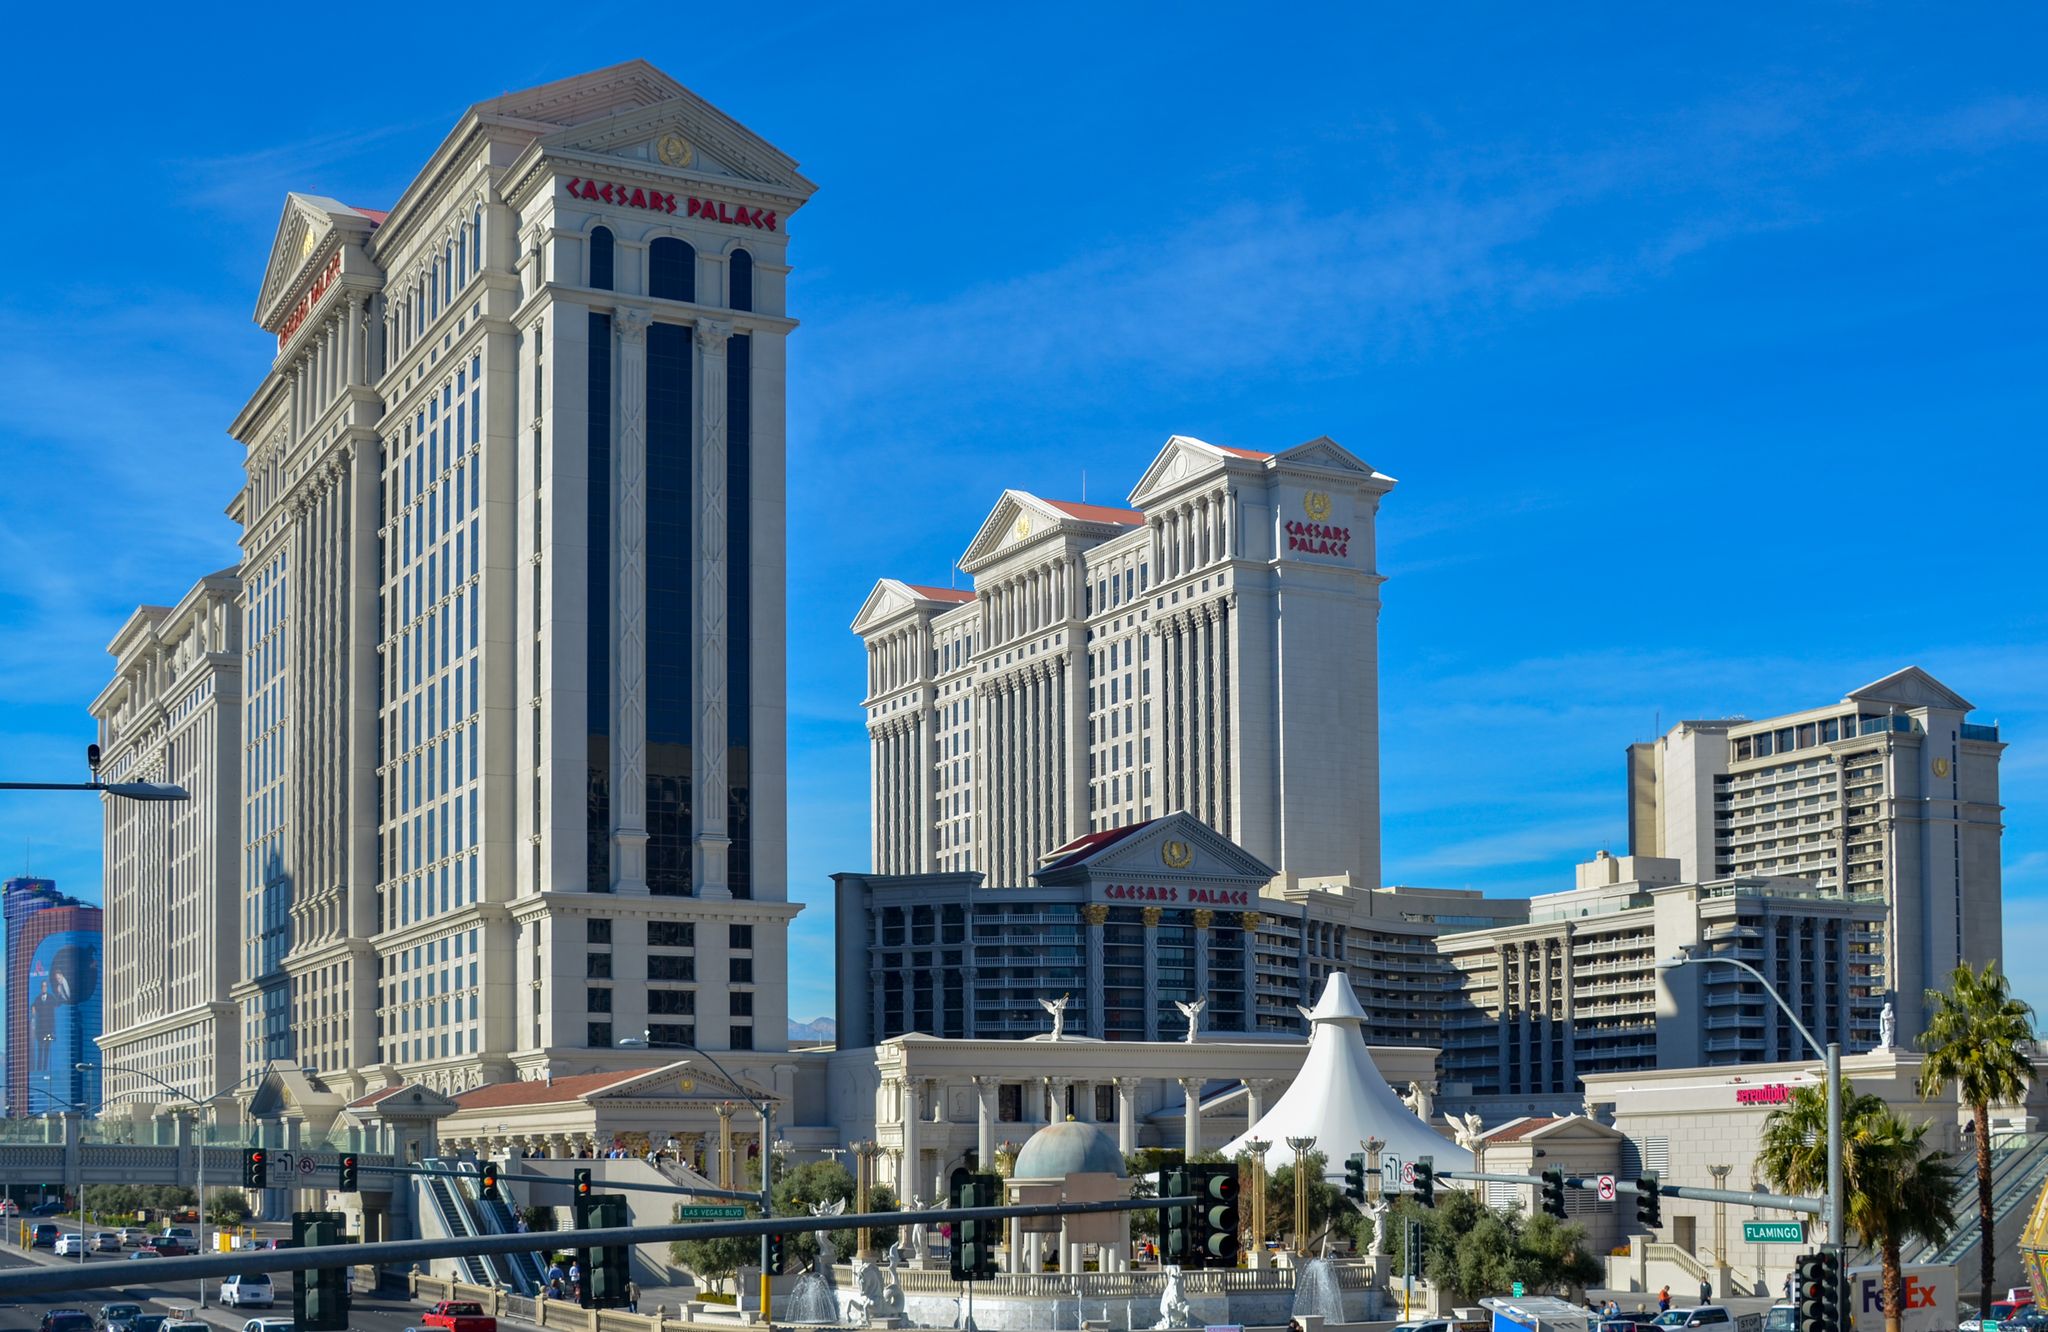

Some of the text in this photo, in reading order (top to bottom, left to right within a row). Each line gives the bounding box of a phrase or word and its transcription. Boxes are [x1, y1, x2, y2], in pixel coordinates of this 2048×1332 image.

[566, 177, 777, 232] CAESARS PALACE
[1285, 520, 1351, 542] CAESARS
[1289, 536, 1347, 558] PALACE
[1104, 884, 1249, 905] CAESARS PALACE
[684, 1208, 742, 1216] LAS VEGAS BLVD
[1746, 1227, 1798, 1238] FLAMINGO
